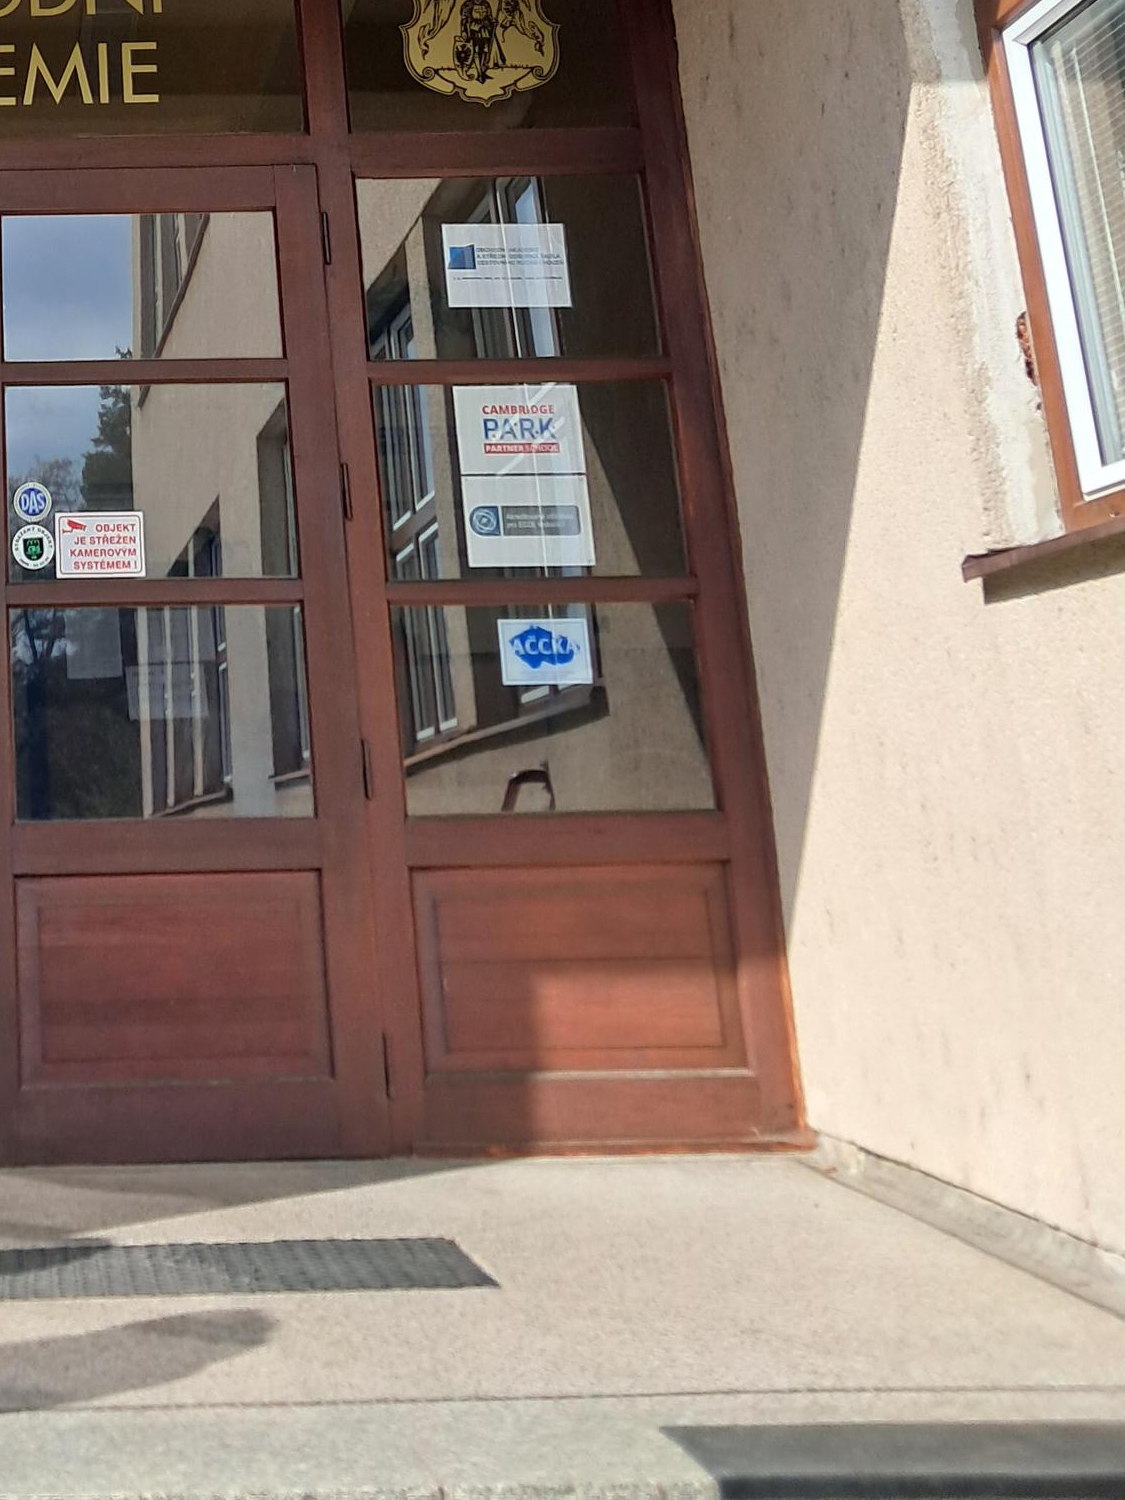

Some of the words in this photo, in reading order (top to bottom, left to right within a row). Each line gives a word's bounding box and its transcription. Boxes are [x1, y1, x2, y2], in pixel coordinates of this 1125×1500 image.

[482, 404, 555, 415] CAMBRIDGE
[95, 523, 136, 532] OBJEKT
[73, 536, 87, 545] JE
[89, 533, 137, 545] STŘEŽEN
[70, 547, 137, 557] KAMEROVÝM
[73, 559, 131, 570] SYSTÉMEM
